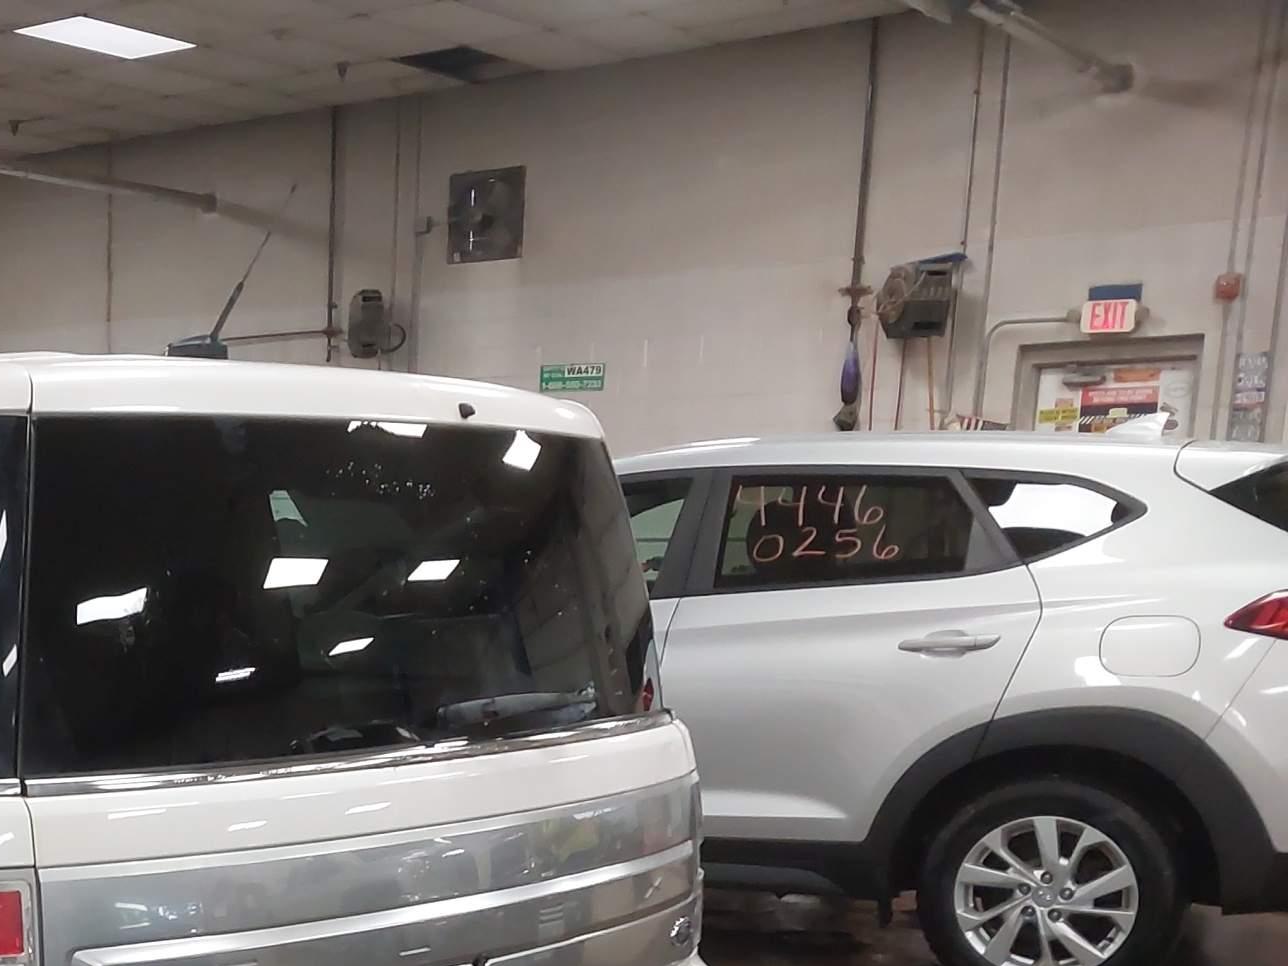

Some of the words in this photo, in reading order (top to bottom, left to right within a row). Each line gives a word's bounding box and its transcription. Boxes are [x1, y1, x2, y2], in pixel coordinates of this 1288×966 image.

[1089, 301, 1130, 330] EXIT
[566, 366, 602, 376] WA479
[733, 483, 884, 527] 4446
[752, 524, 901, 562] 0256
